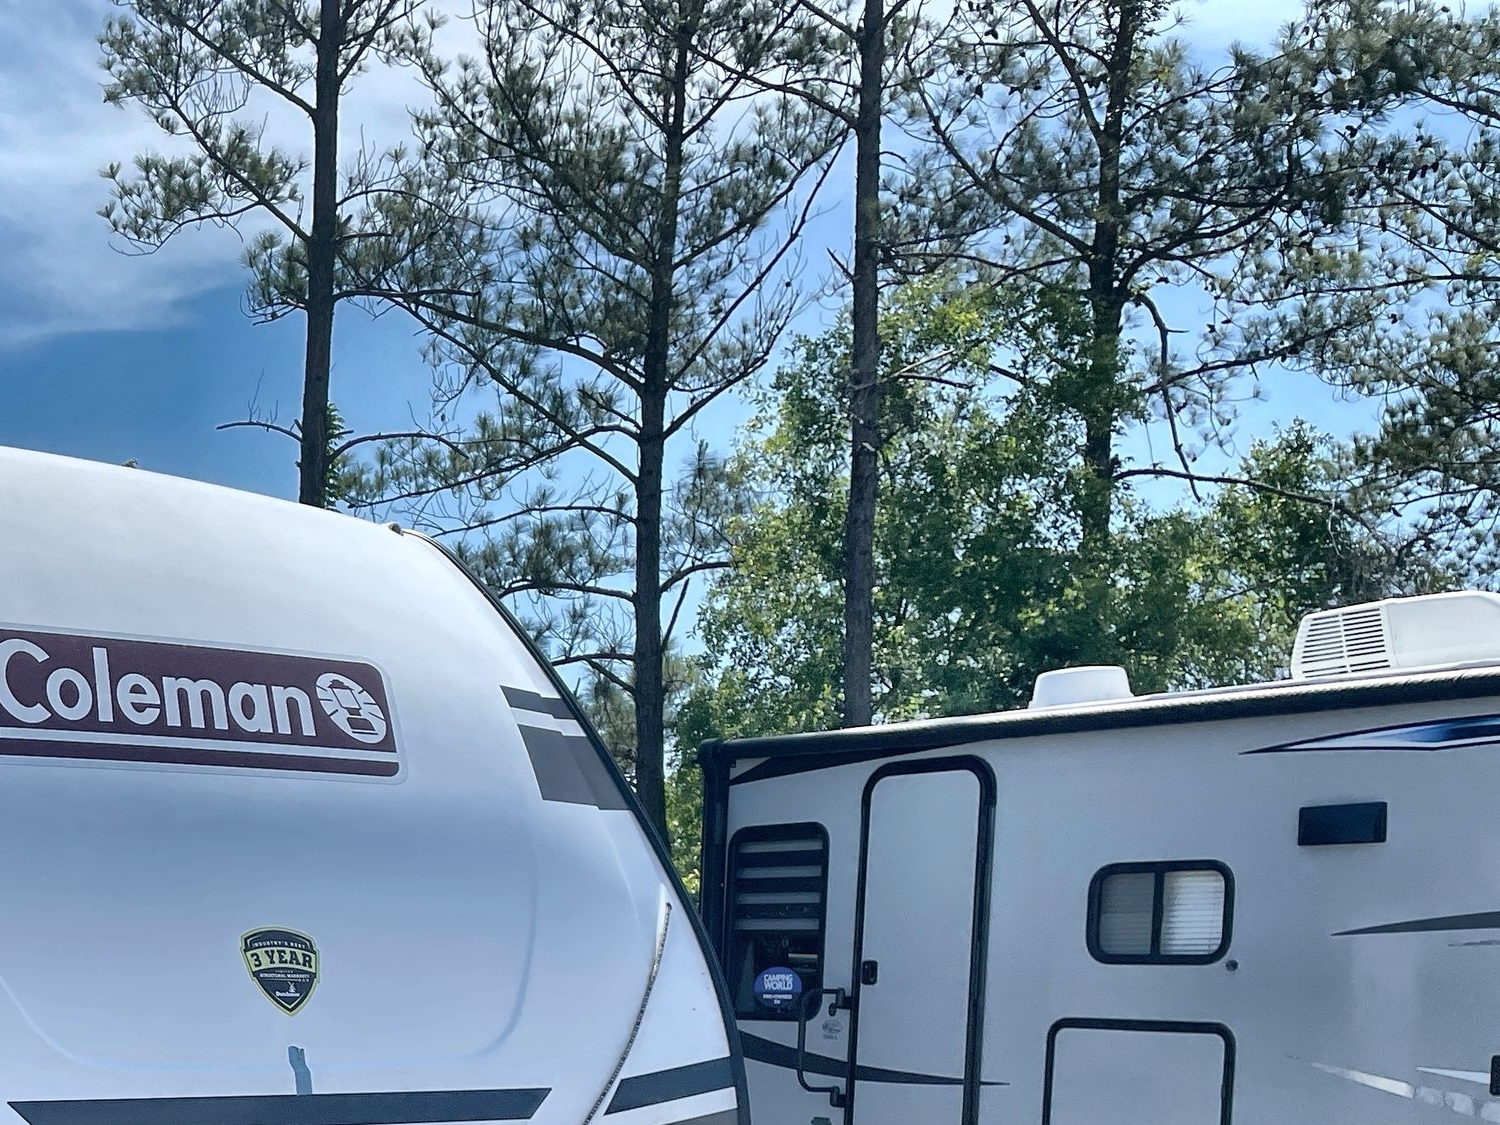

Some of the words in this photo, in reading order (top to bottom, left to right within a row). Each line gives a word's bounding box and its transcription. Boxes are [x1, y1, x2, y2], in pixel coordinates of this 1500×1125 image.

[250, 952, 262, 968] 3
[264, 949, 313, 969] YEAR
[763, 980, 793, 990] WORLD
